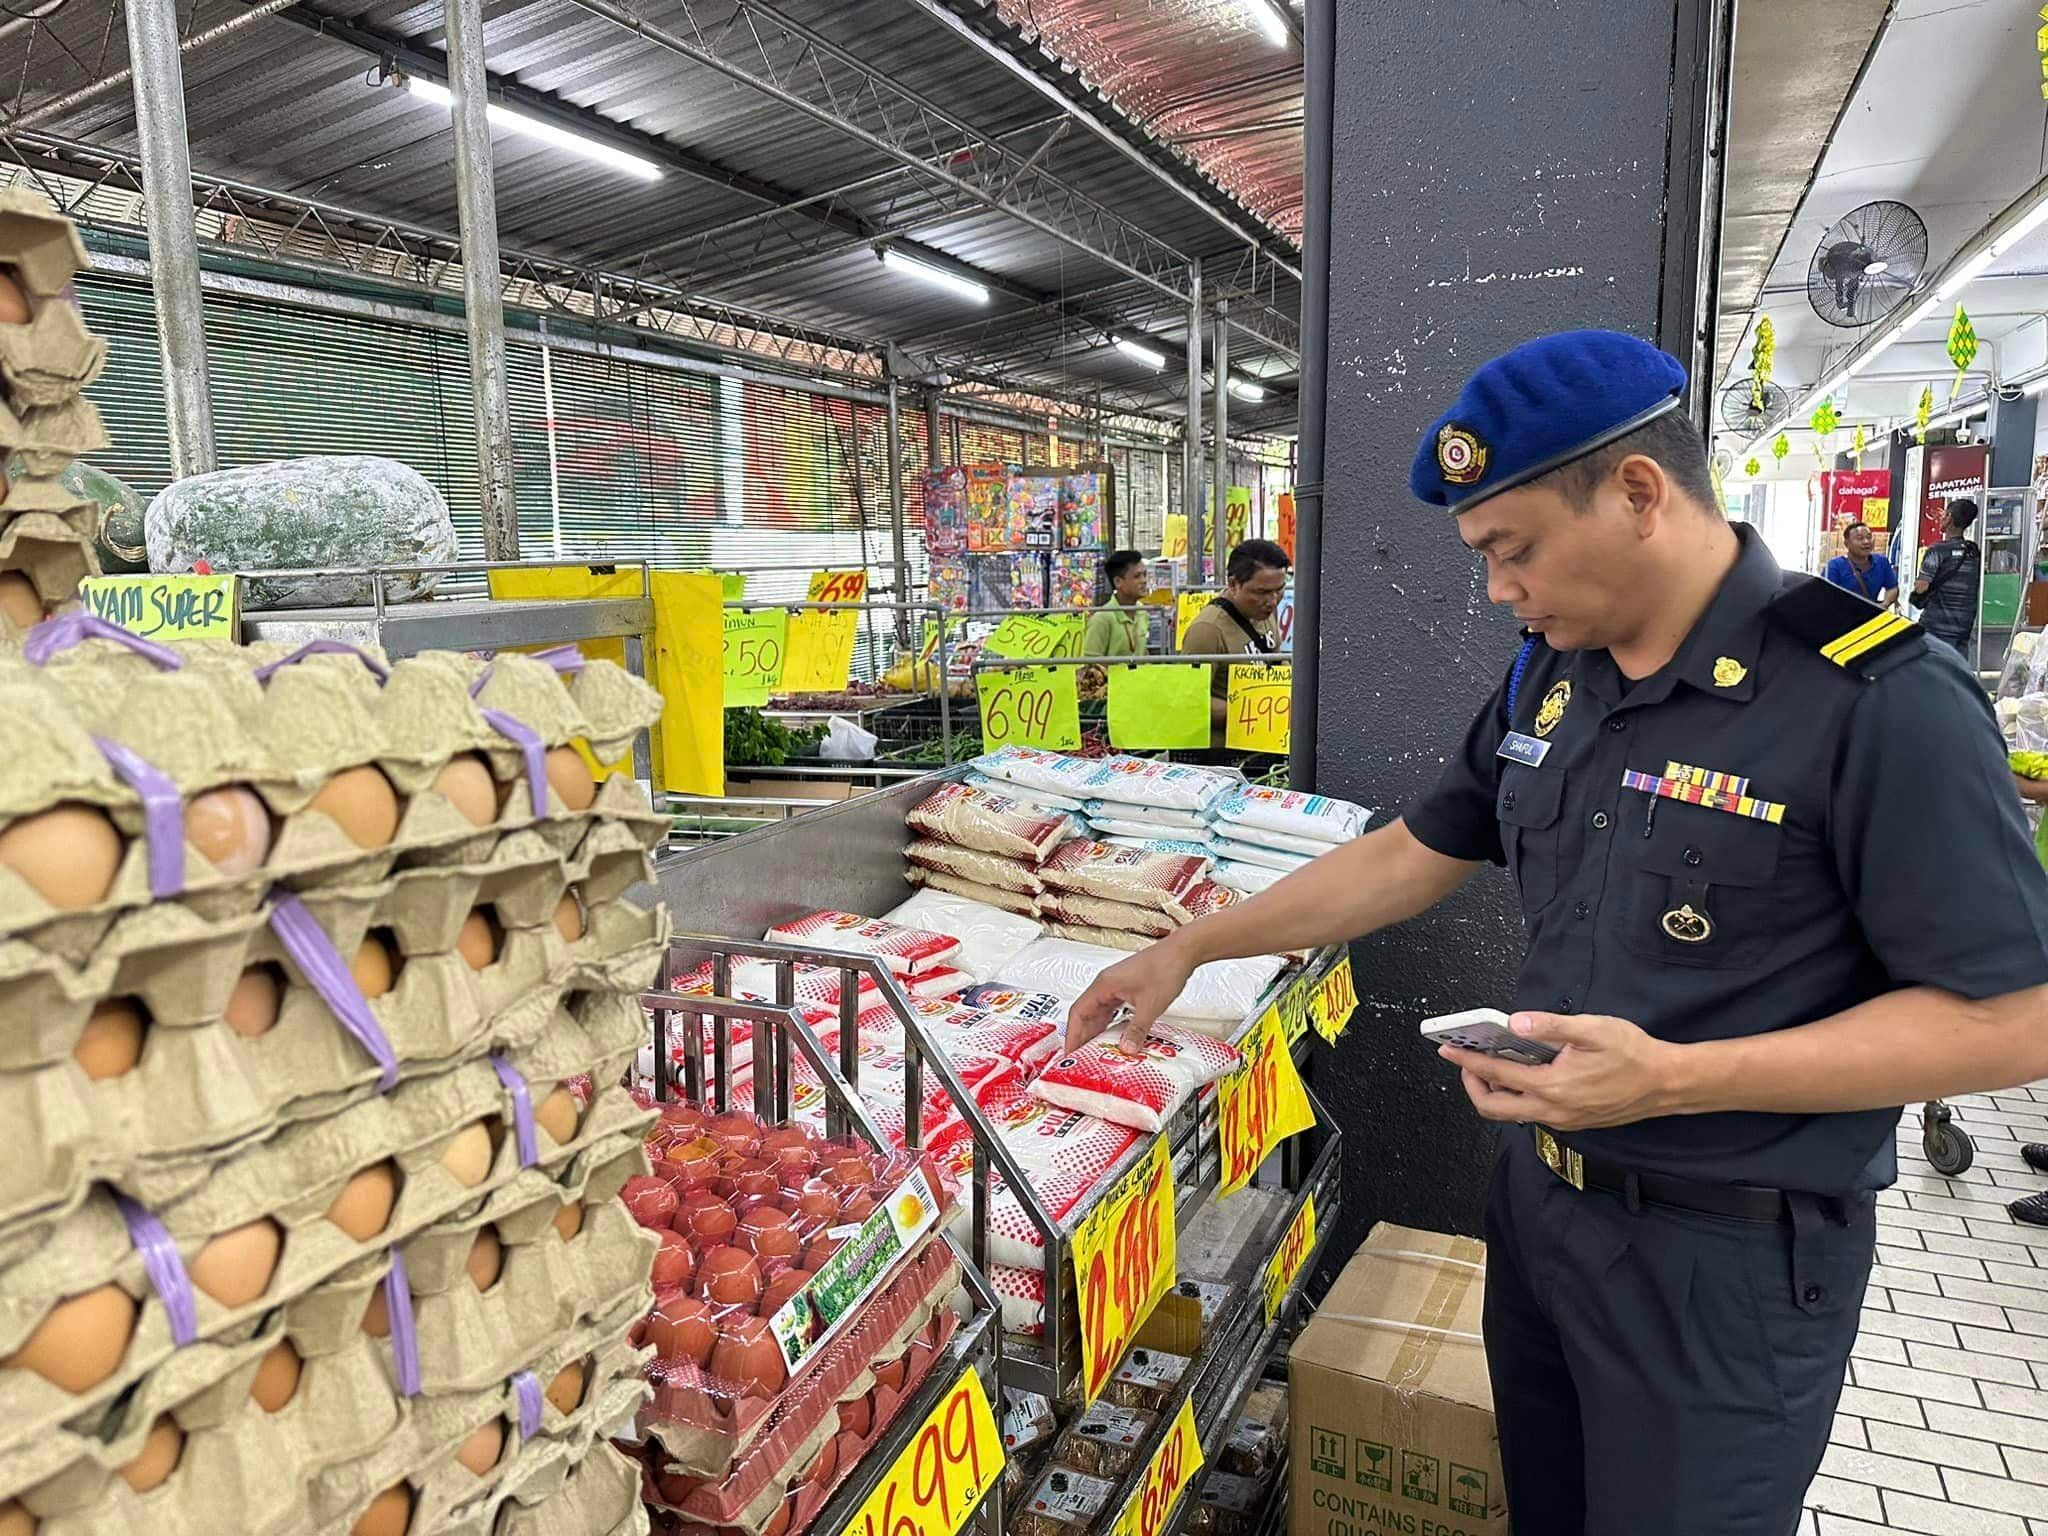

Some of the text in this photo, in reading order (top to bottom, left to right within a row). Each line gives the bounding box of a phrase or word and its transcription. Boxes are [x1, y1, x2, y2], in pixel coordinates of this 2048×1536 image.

[1838, 486, 1878, 496] dahaga?
[1928, 477, 1981, 491] DAPATKAN
[81, 584, 228, 636] AYAM SUPER
[997, 620, 1050, 655] 5.90
[986, 688, 1054, 741] 6.99
[1037, 1112, 1069, 1137] GUL
[1313, 1488, 1416, 1535] CONTAINS
[1421, 1518, 1480, 1536] EG
